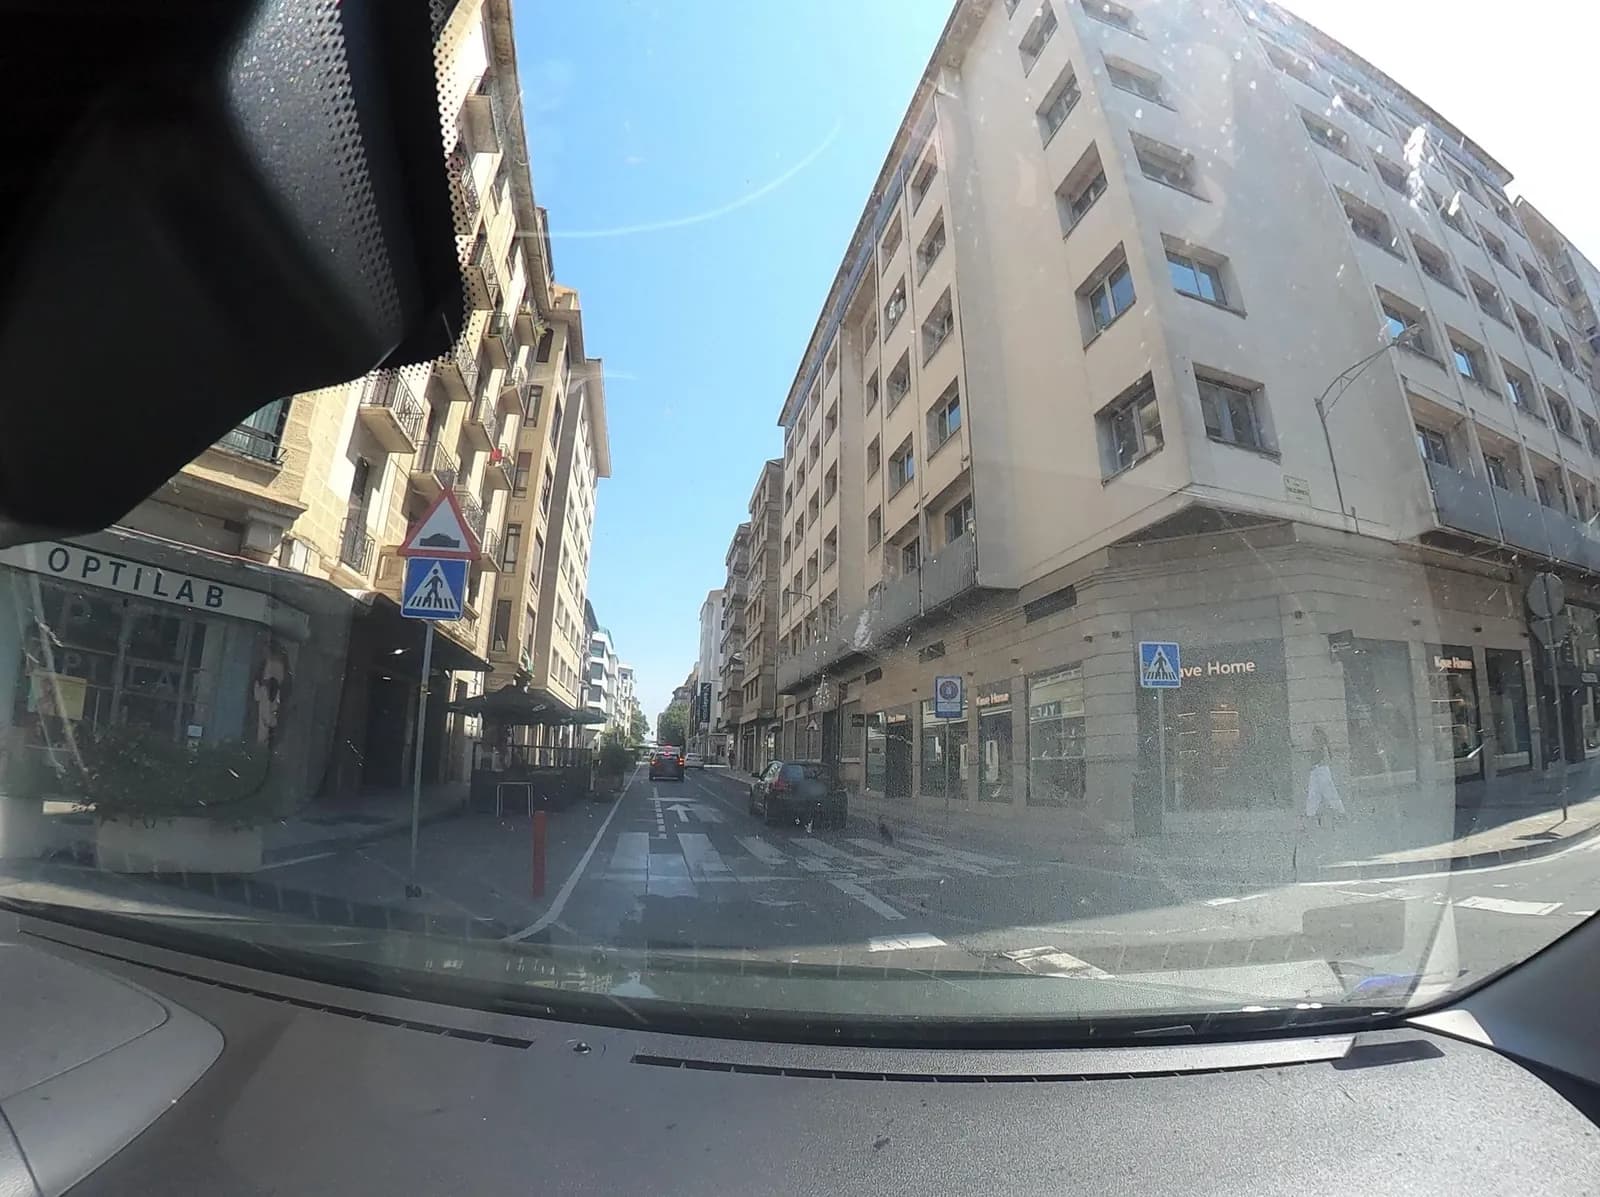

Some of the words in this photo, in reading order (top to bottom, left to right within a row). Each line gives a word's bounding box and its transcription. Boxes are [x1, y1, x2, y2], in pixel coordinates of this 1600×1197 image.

[48, 547, 224, 608] OPTILAB
[1180, 666, 1202, 678] ve
[1207, 661, 1256, 675] Home
